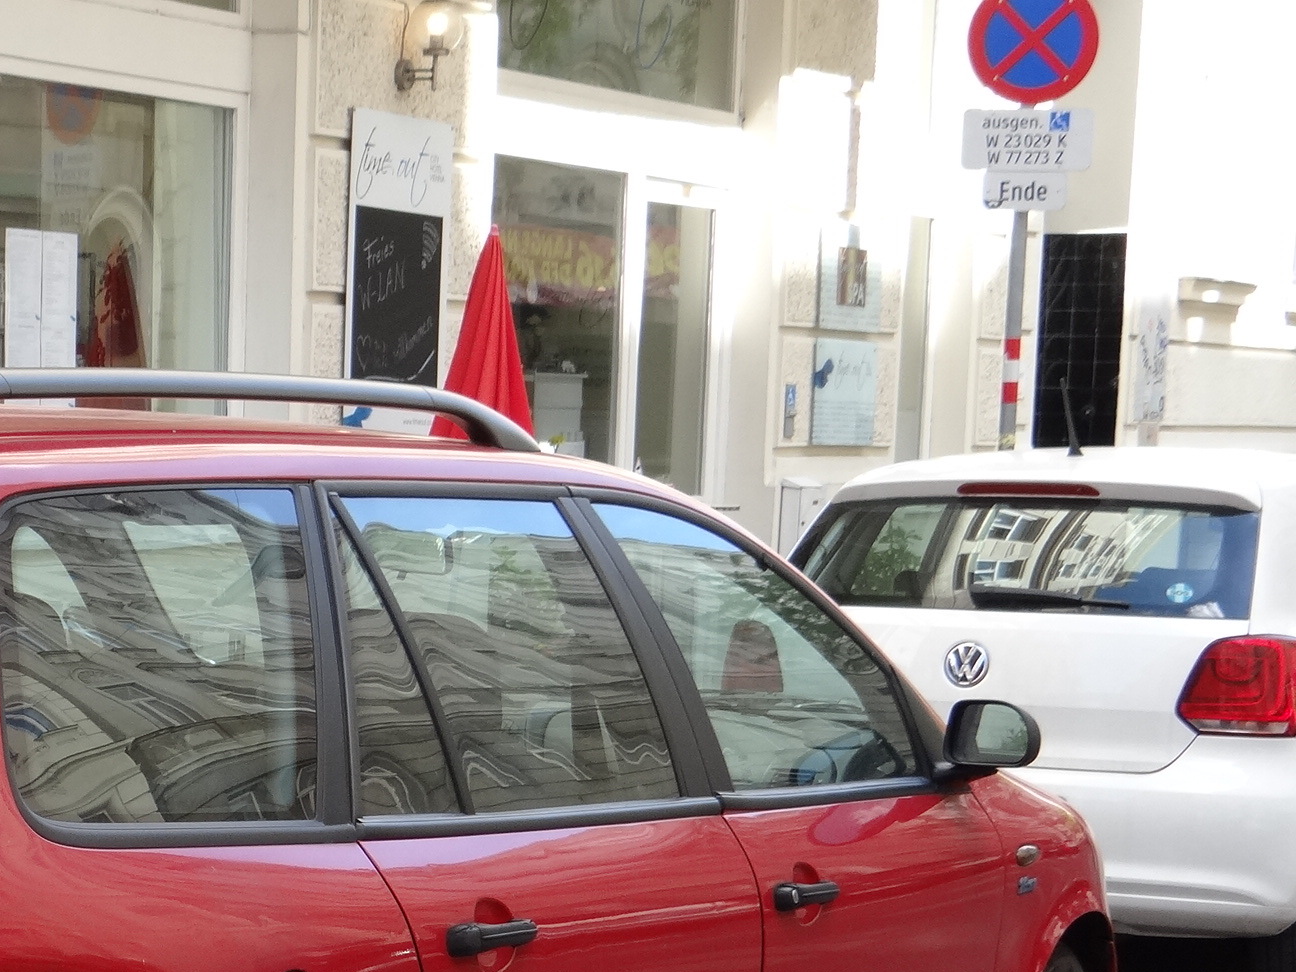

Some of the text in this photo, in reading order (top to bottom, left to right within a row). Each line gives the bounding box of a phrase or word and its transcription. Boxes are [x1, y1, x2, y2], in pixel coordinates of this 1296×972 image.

[982, 116, 1044, 132] ausgen.
[986, 134, 999, 148] W
[1057, 134, 1067, 148] K
[987, 150, 1001, 165] W
[1054, 150, 1065, 165] Z
[999, 180, 1048, 201] Ende
[363, 235, 395, 269] Freies
[358, 260, 405, 311] W-LAN
